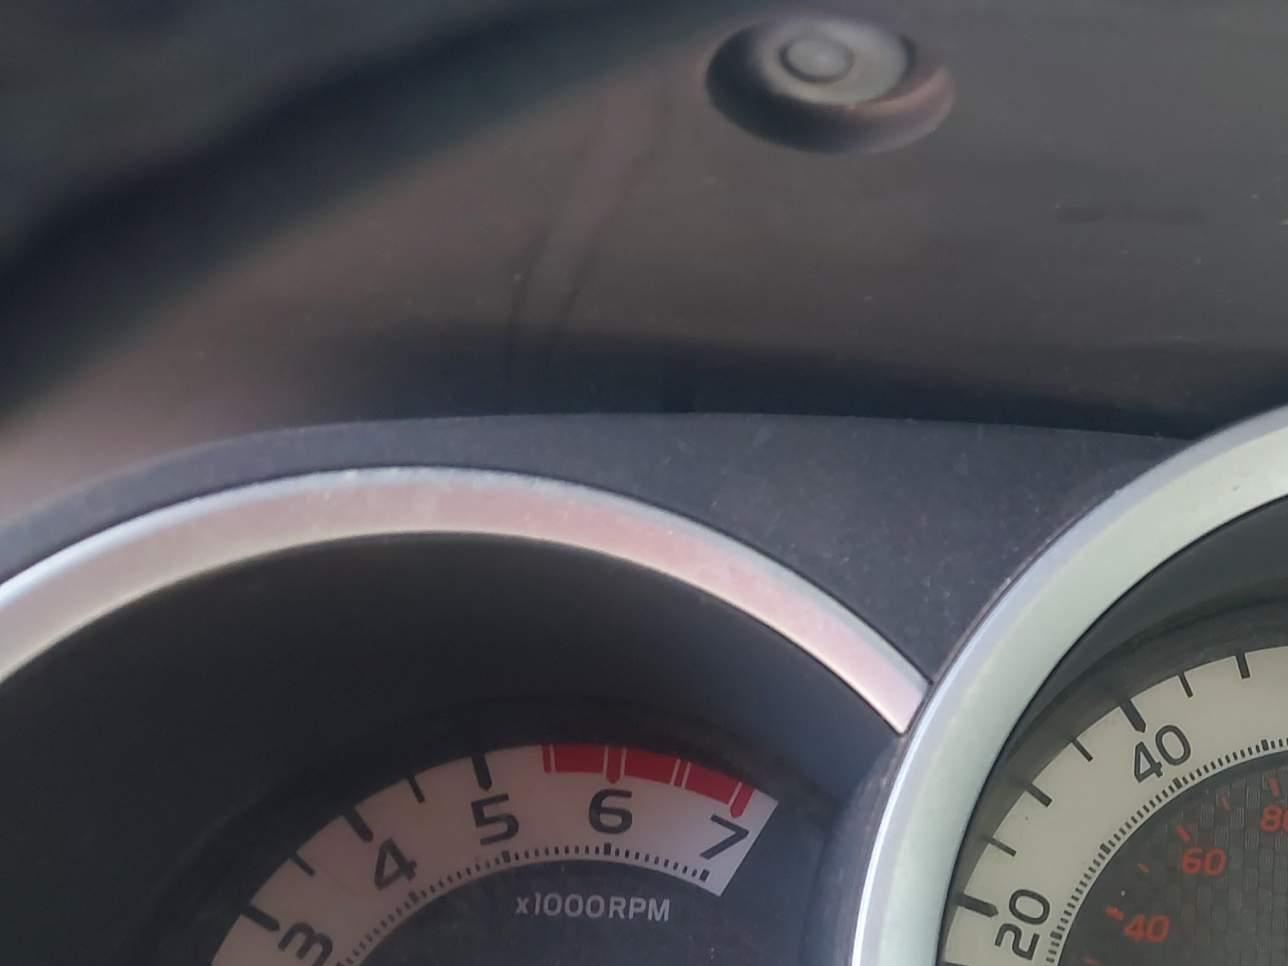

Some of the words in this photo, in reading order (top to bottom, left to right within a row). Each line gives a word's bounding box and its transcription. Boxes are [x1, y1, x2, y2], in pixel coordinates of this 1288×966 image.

[1134, 725, 1190, 784] 40
[471, 793, 520, 846] 5
[588, 788, 633, 834] 6
[699, 814, 750, 861] 7
[373, 838, 418, 890] 4
[1181, 847, 1227, 878] 60
[995, 889, 1050, 960] 20
[1123, 914, 1170, 943] 40
